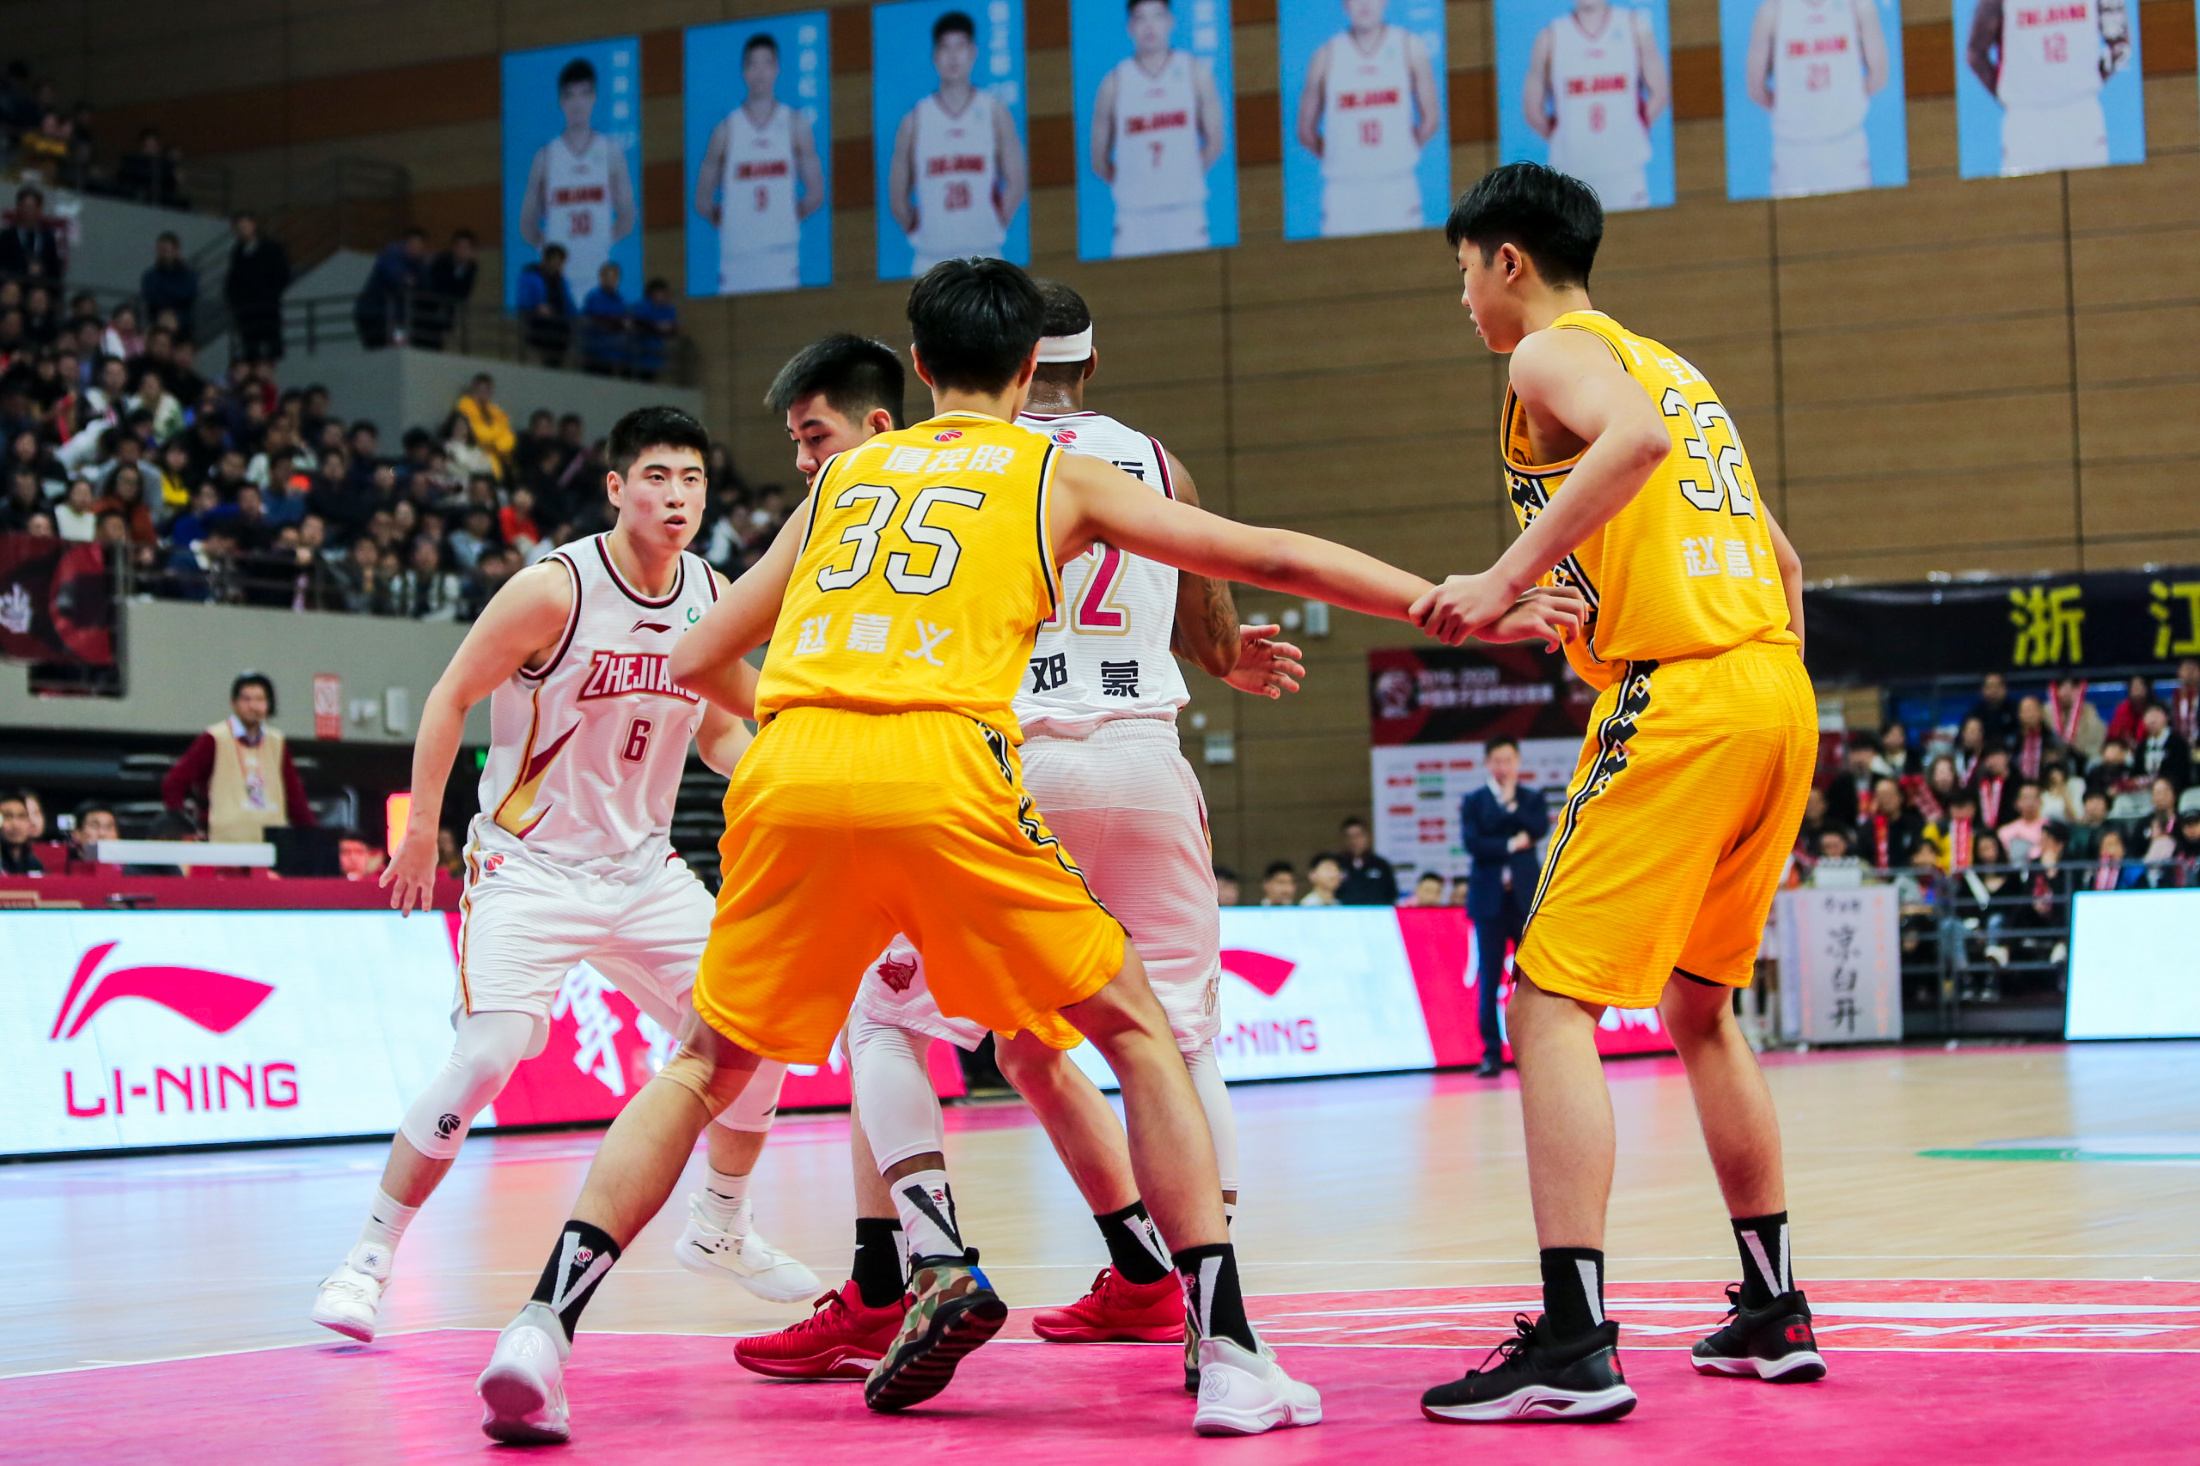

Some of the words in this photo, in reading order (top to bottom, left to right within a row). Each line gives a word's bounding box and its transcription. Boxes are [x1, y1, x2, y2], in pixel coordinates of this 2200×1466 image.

[842, 443, 1015, 475] 广厦控股
[1661, 387, 1756, 521] 32
[816, 483, 986, 596] 35
[793, 613, 953, 667] 赵嘉义
[2009, 580, 2200, 666] 浙江
[581, 652, 700, 702] ZHEJIA
[1029, 652, 1140, 698] 邓蒙
[620, 716, 655, 764] 6
[1214, 1019, 1319, 1056] I-NING
[64, 1063, 300, 1118] LI-NING
